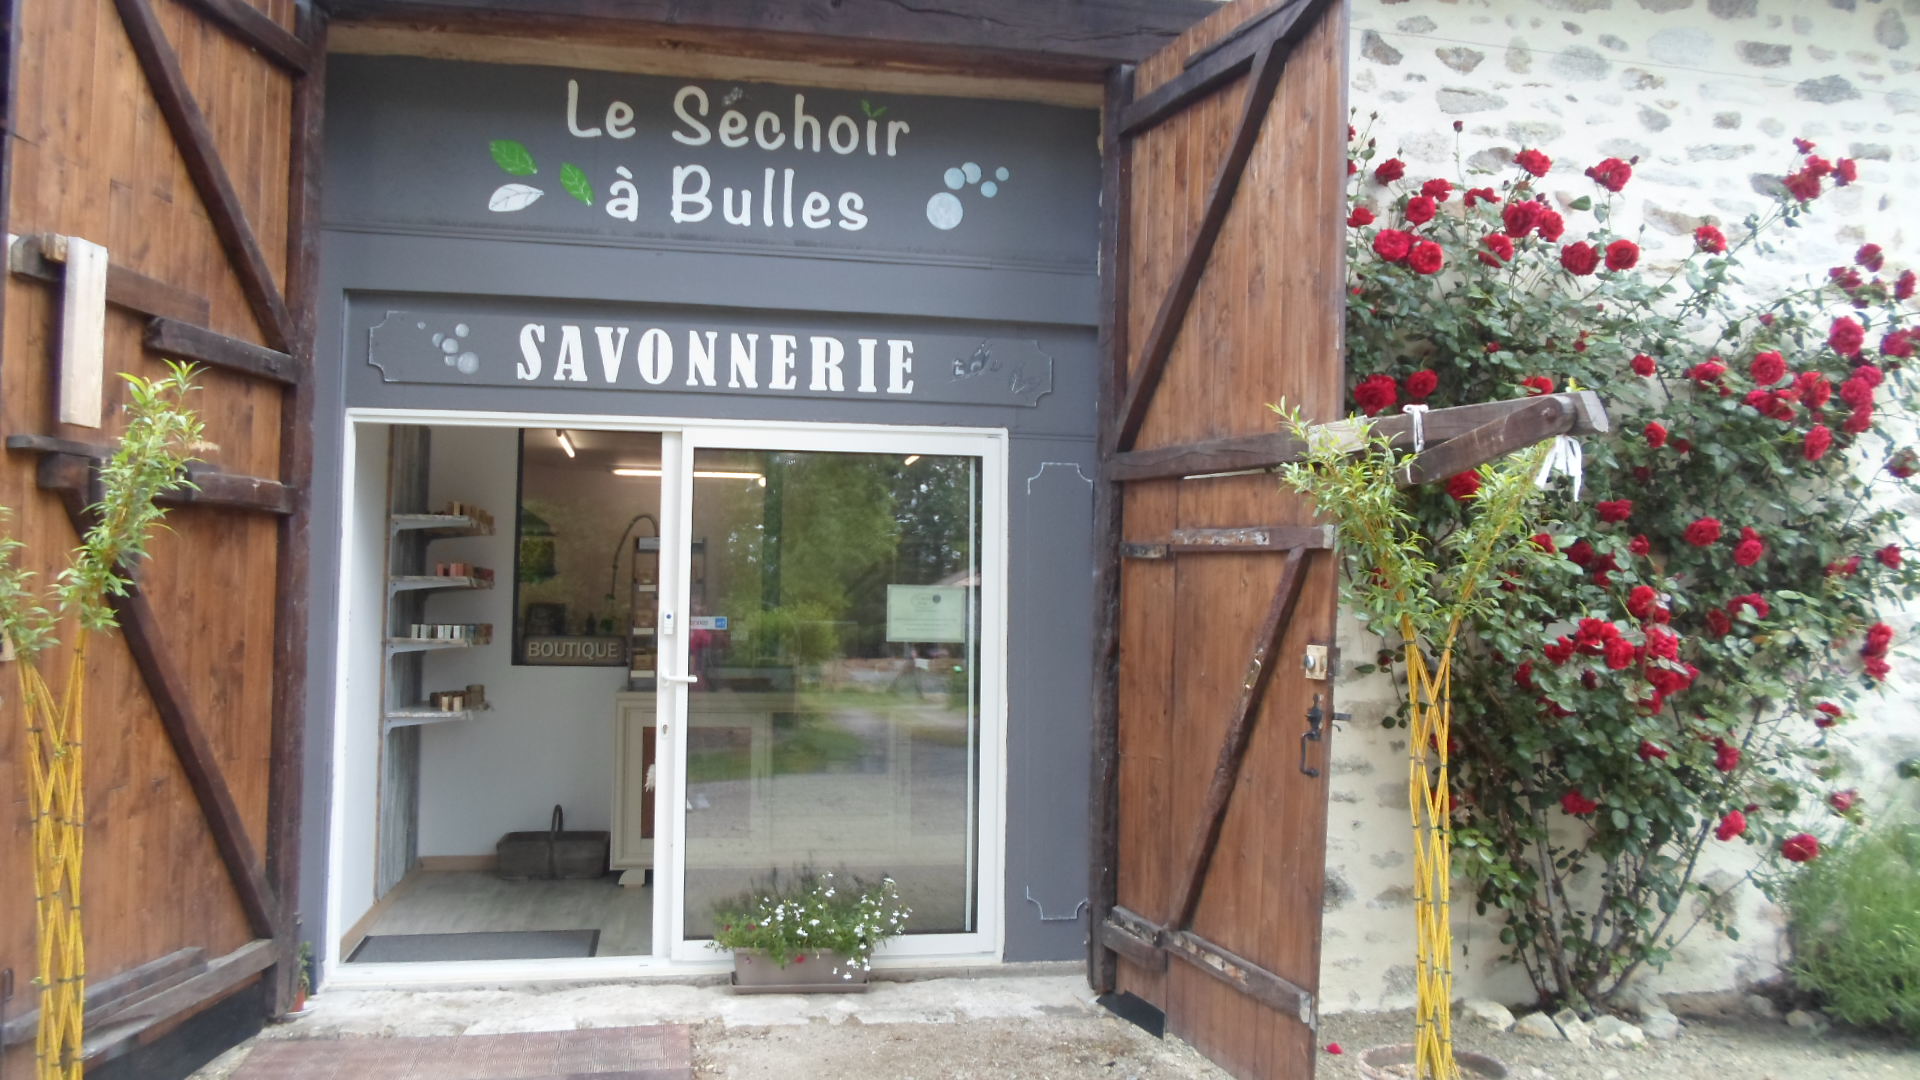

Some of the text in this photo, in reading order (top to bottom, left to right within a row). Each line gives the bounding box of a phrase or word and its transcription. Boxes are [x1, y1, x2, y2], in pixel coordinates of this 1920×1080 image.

[567, 79, 636, 139] Le
[605, 164, 869, 231] à Bulles
[516, 323, 914, 394] SAVONNERIE
[528, 641, 618, 659] BOUTIQUE
